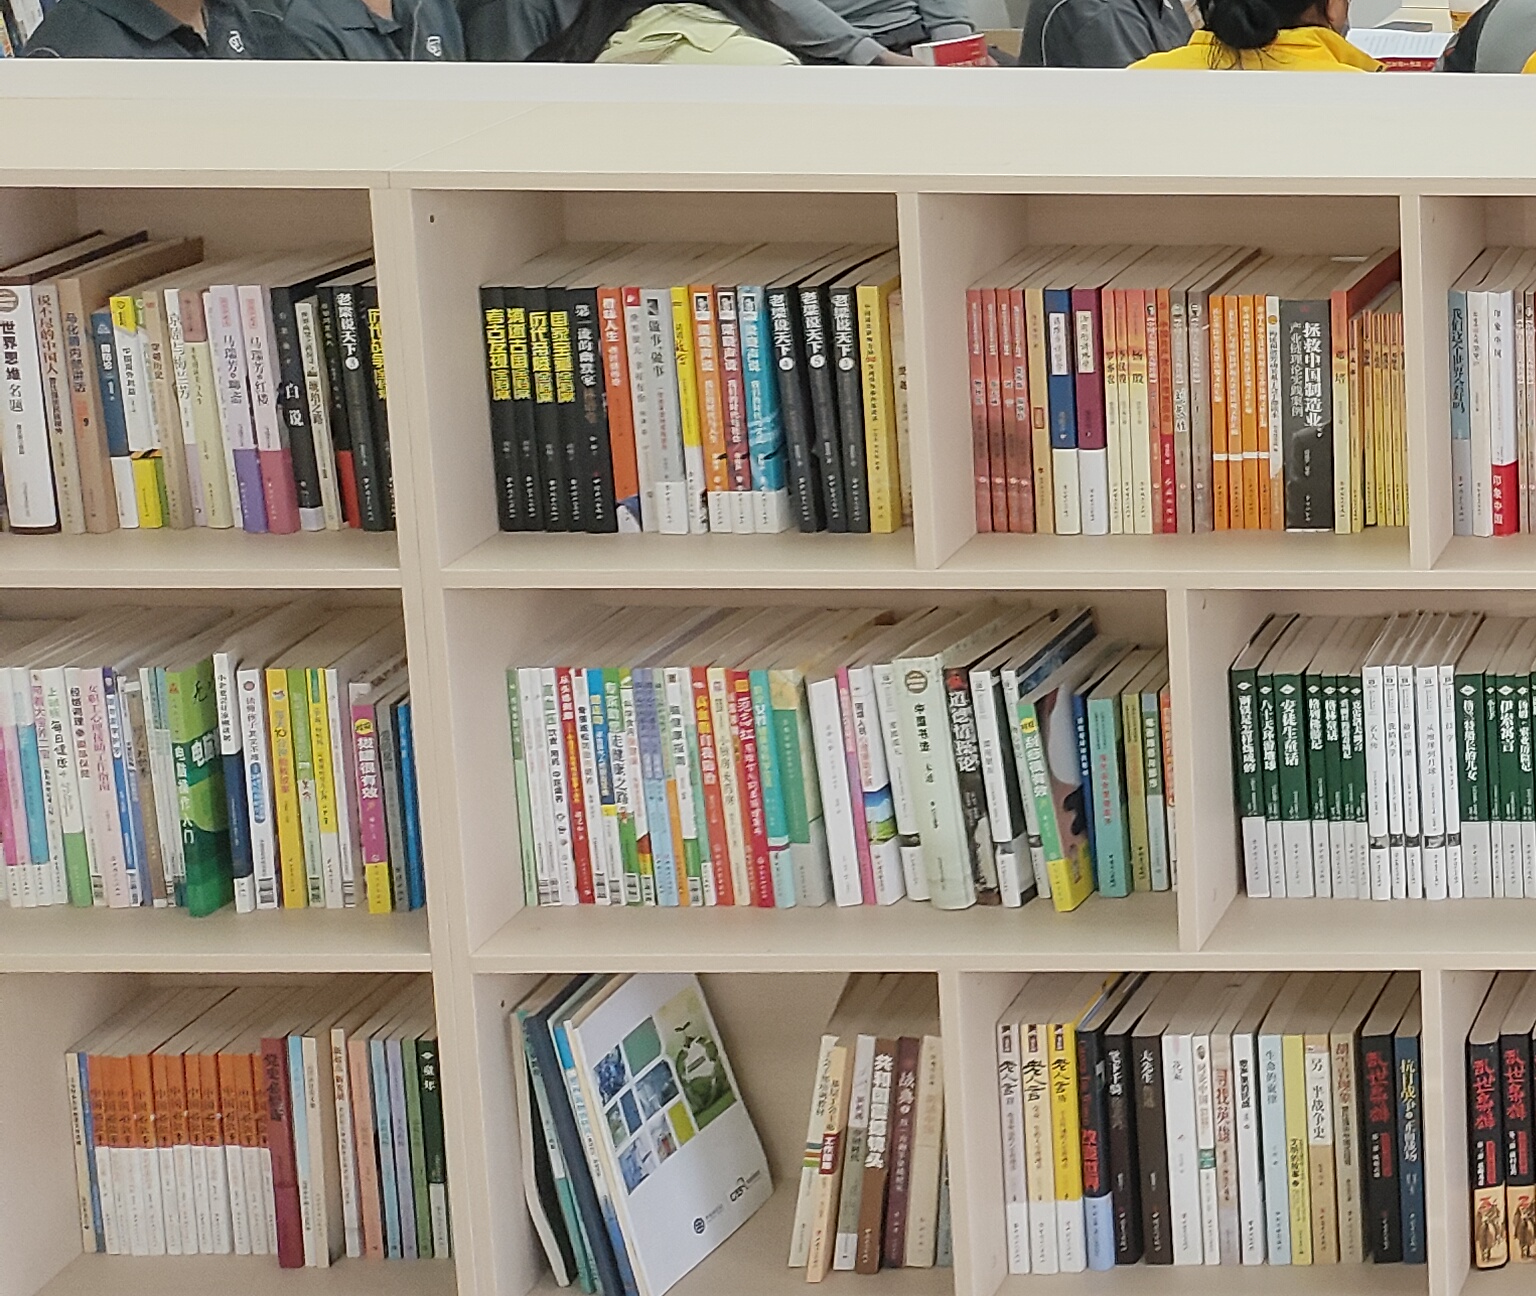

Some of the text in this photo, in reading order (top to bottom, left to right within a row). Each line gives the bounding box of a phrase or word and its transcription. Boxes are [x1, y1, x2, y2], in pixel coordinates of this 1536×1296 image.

[285, 382, 304, 427] 白说
[1500, 700, 1515, 753] 伊索寓言
